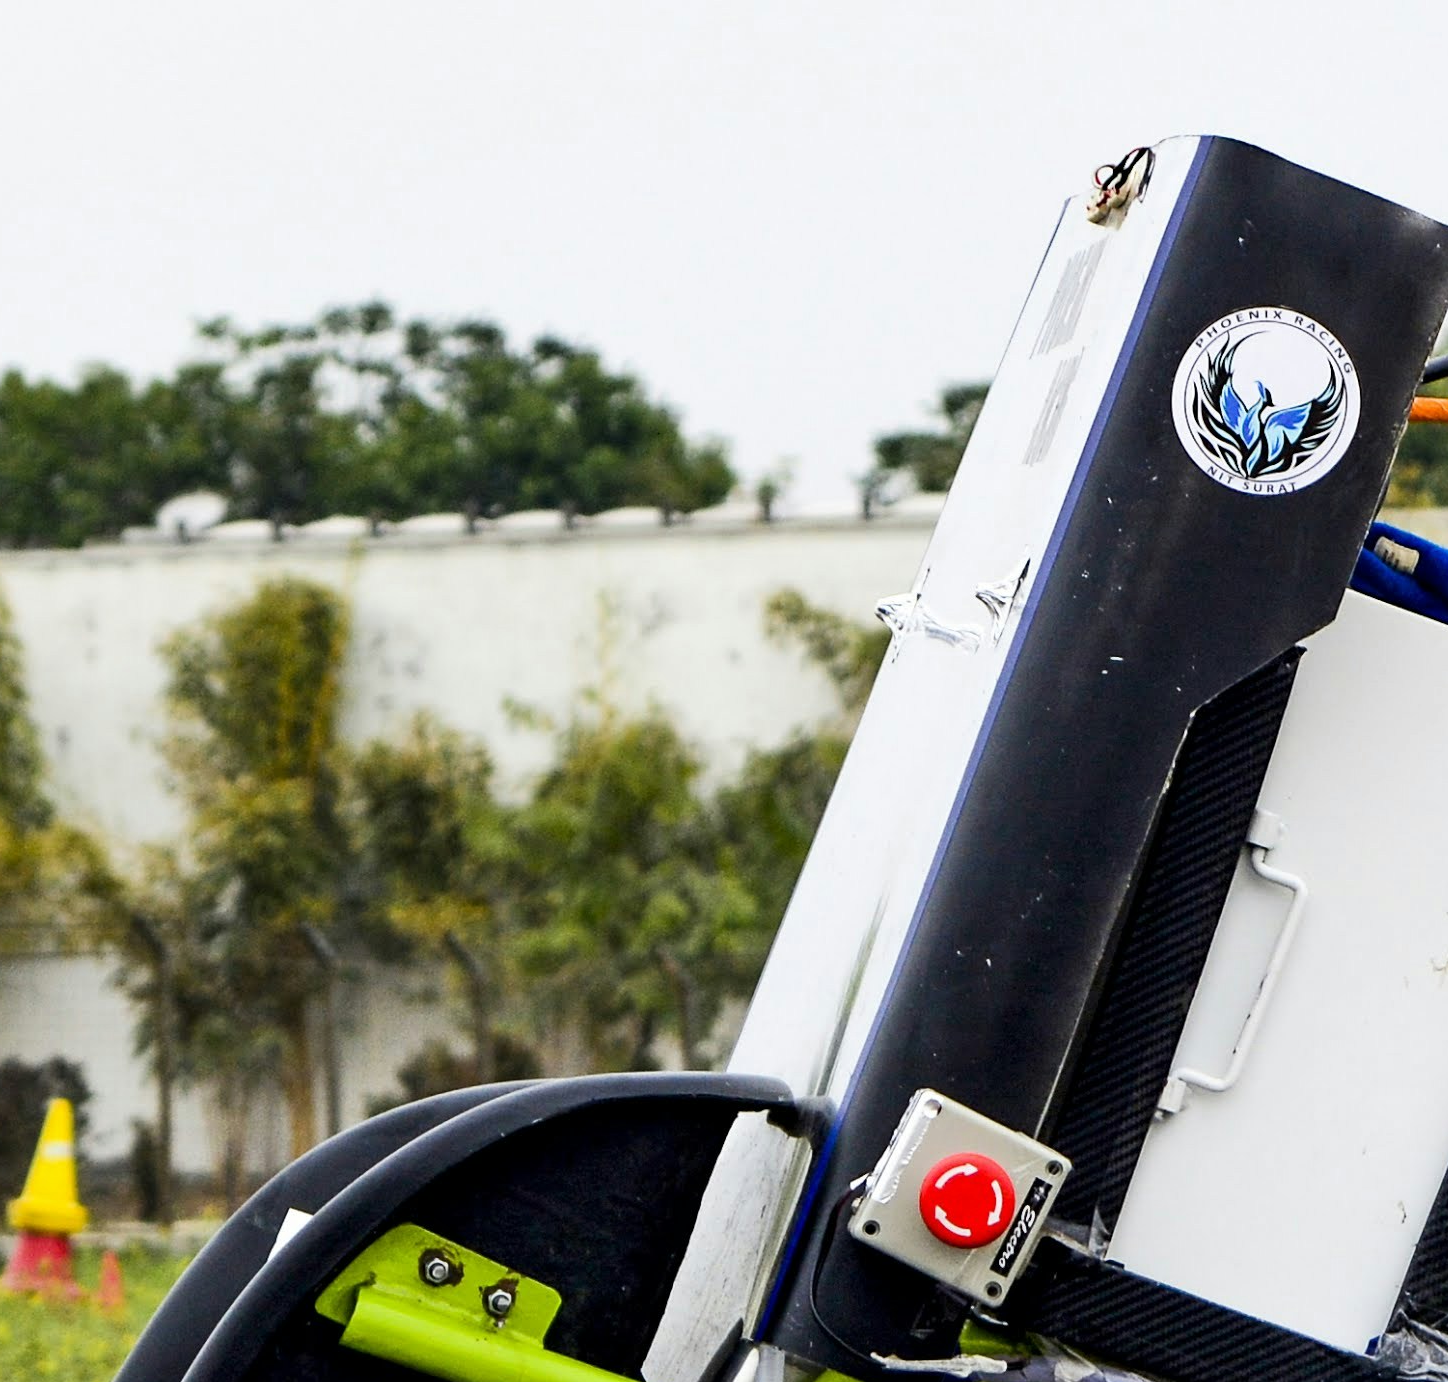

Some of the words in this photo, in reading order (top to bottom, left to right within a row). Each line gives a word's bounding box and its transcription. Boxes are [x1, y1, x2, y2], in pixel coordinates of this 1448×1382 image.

[1195, 310, 1283, 349] PHOENIX
[1294, 315, 1354, 374] RACING
[1207, 465, 1233, 484] NIT
[1242, 481, 1298, 494] SURAT
[998, 1205, 1036, 1269] Electro
